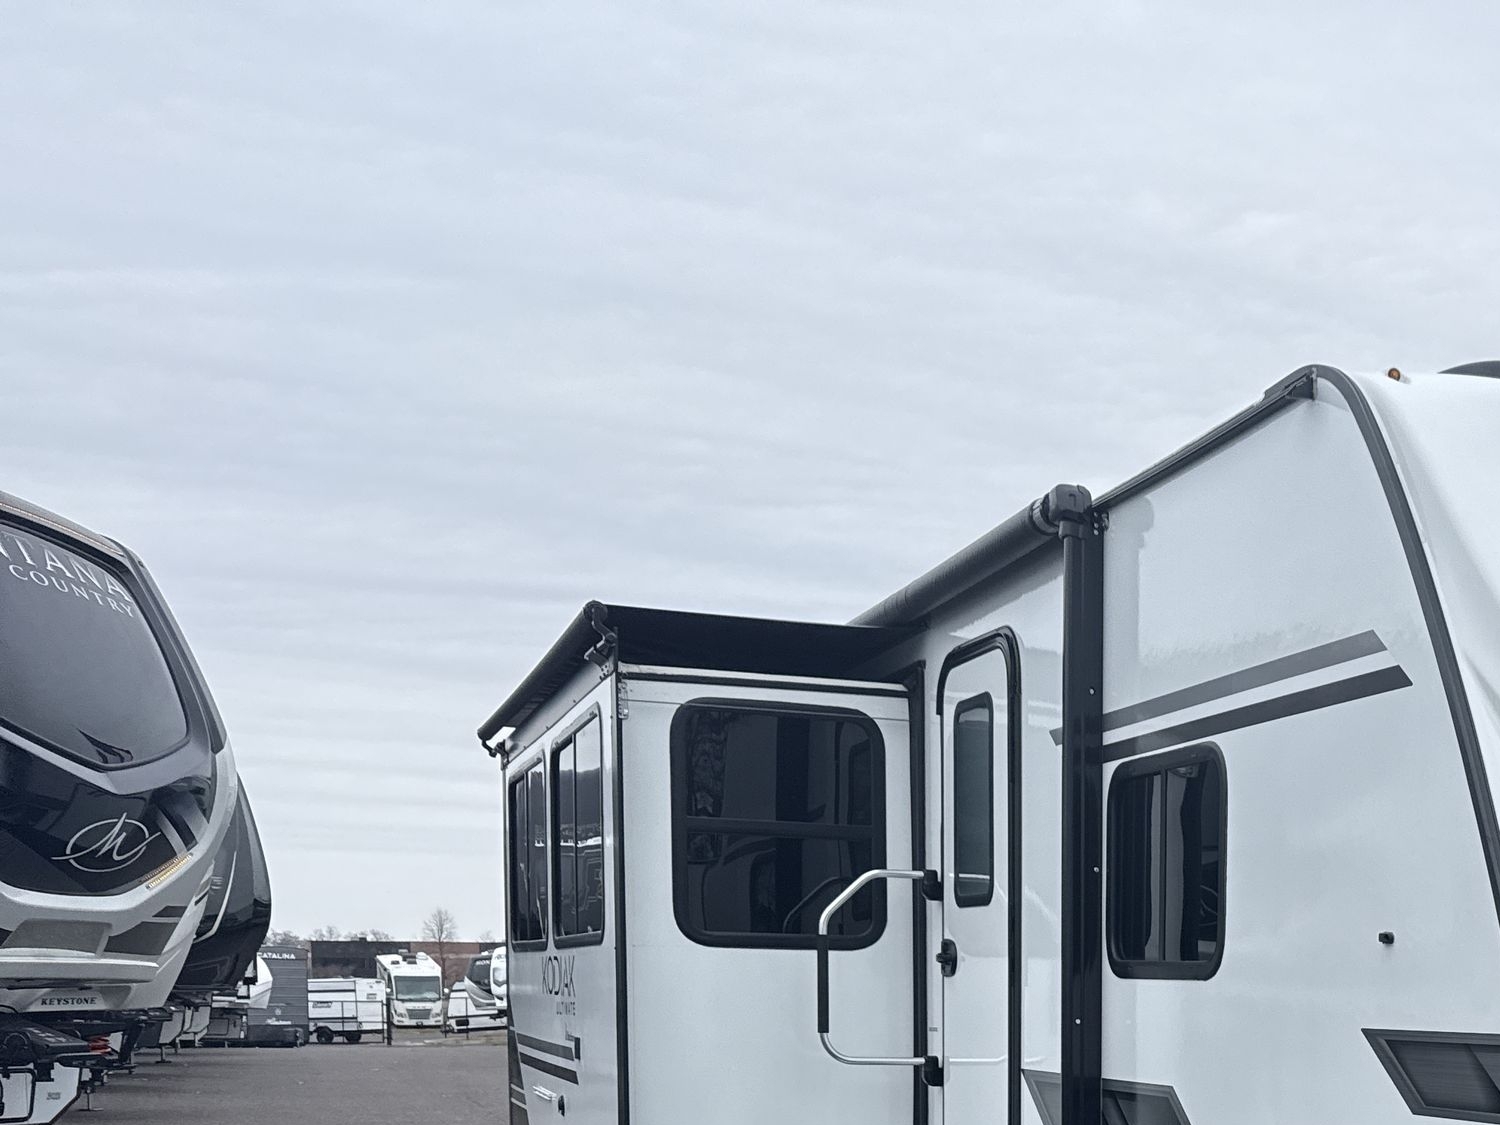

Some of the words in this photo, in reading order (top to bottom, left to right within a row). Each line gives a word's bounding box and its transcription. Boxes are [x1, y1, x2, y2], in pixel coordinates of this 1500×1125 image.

[0, 530, 133, 602] TANA
[8, 563, 134, 617] COUNTRY
[541, 955, 576, 997] KODIAK
[41, 996, 98, 1006] KEYSTONE
